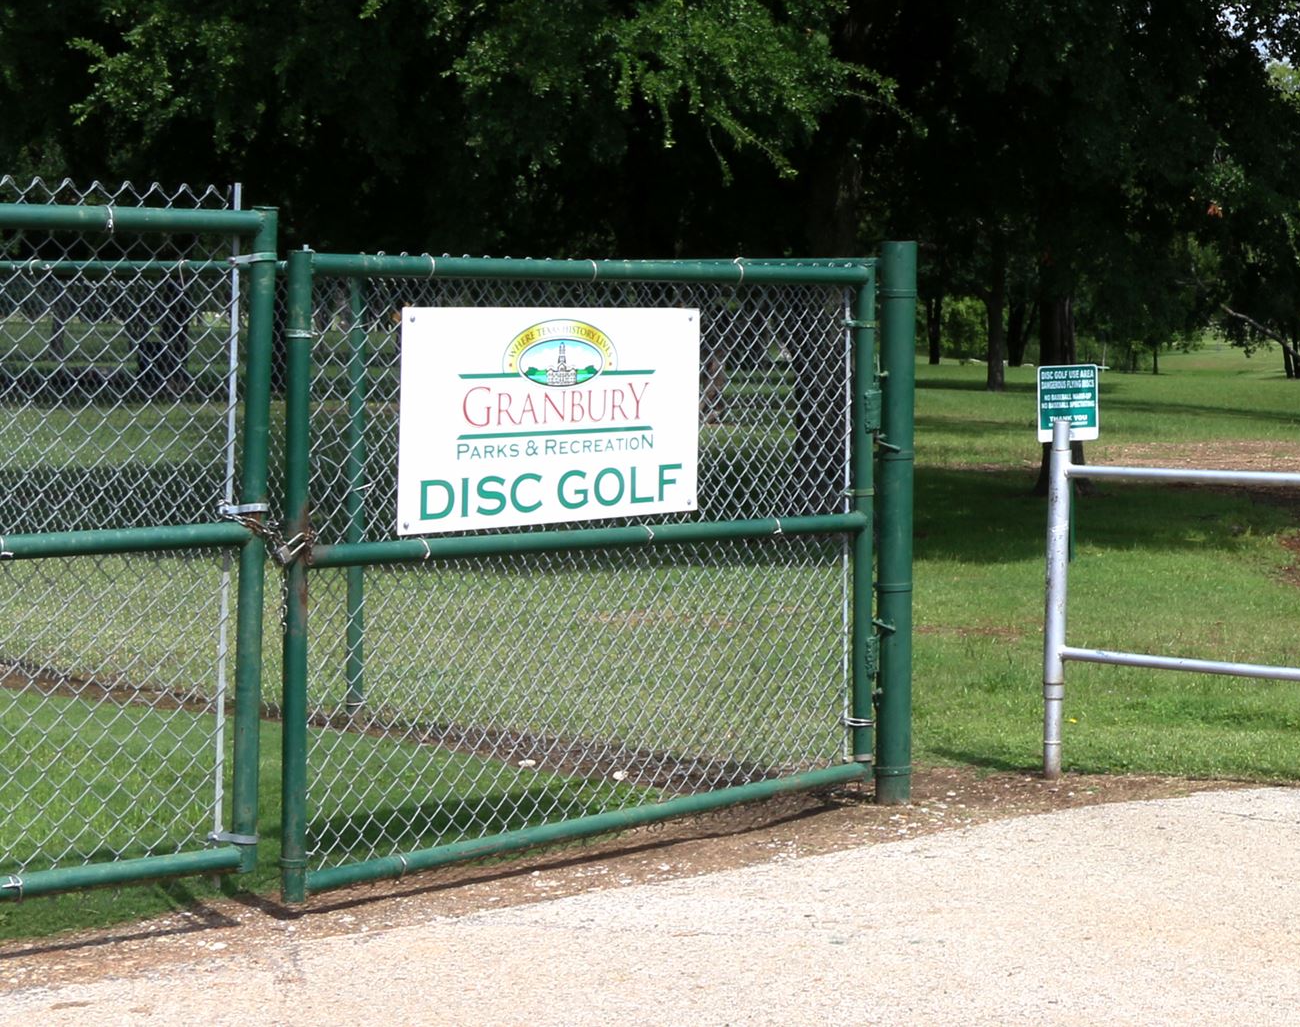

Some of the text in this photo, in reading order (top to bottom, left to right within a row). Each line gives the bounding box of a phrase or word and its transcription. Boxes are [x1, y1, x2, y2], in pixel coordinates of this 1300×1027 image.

[508, 331, 535, 358] WHERE
[562, 325, 597, 342] HISTORY
[595, 334, 614, 358] LIVES
[1041, 371, 1054, 380] DISC
[1054, 370, 1067, 379] GOLF
[462, 382, 649, 428] GRANBURY
[1073, 414, 1088, 422] YOU
[456, 434, 653, 460] PARKS & RECREATION
[419, 463, 683, 520] DISC GOLF
